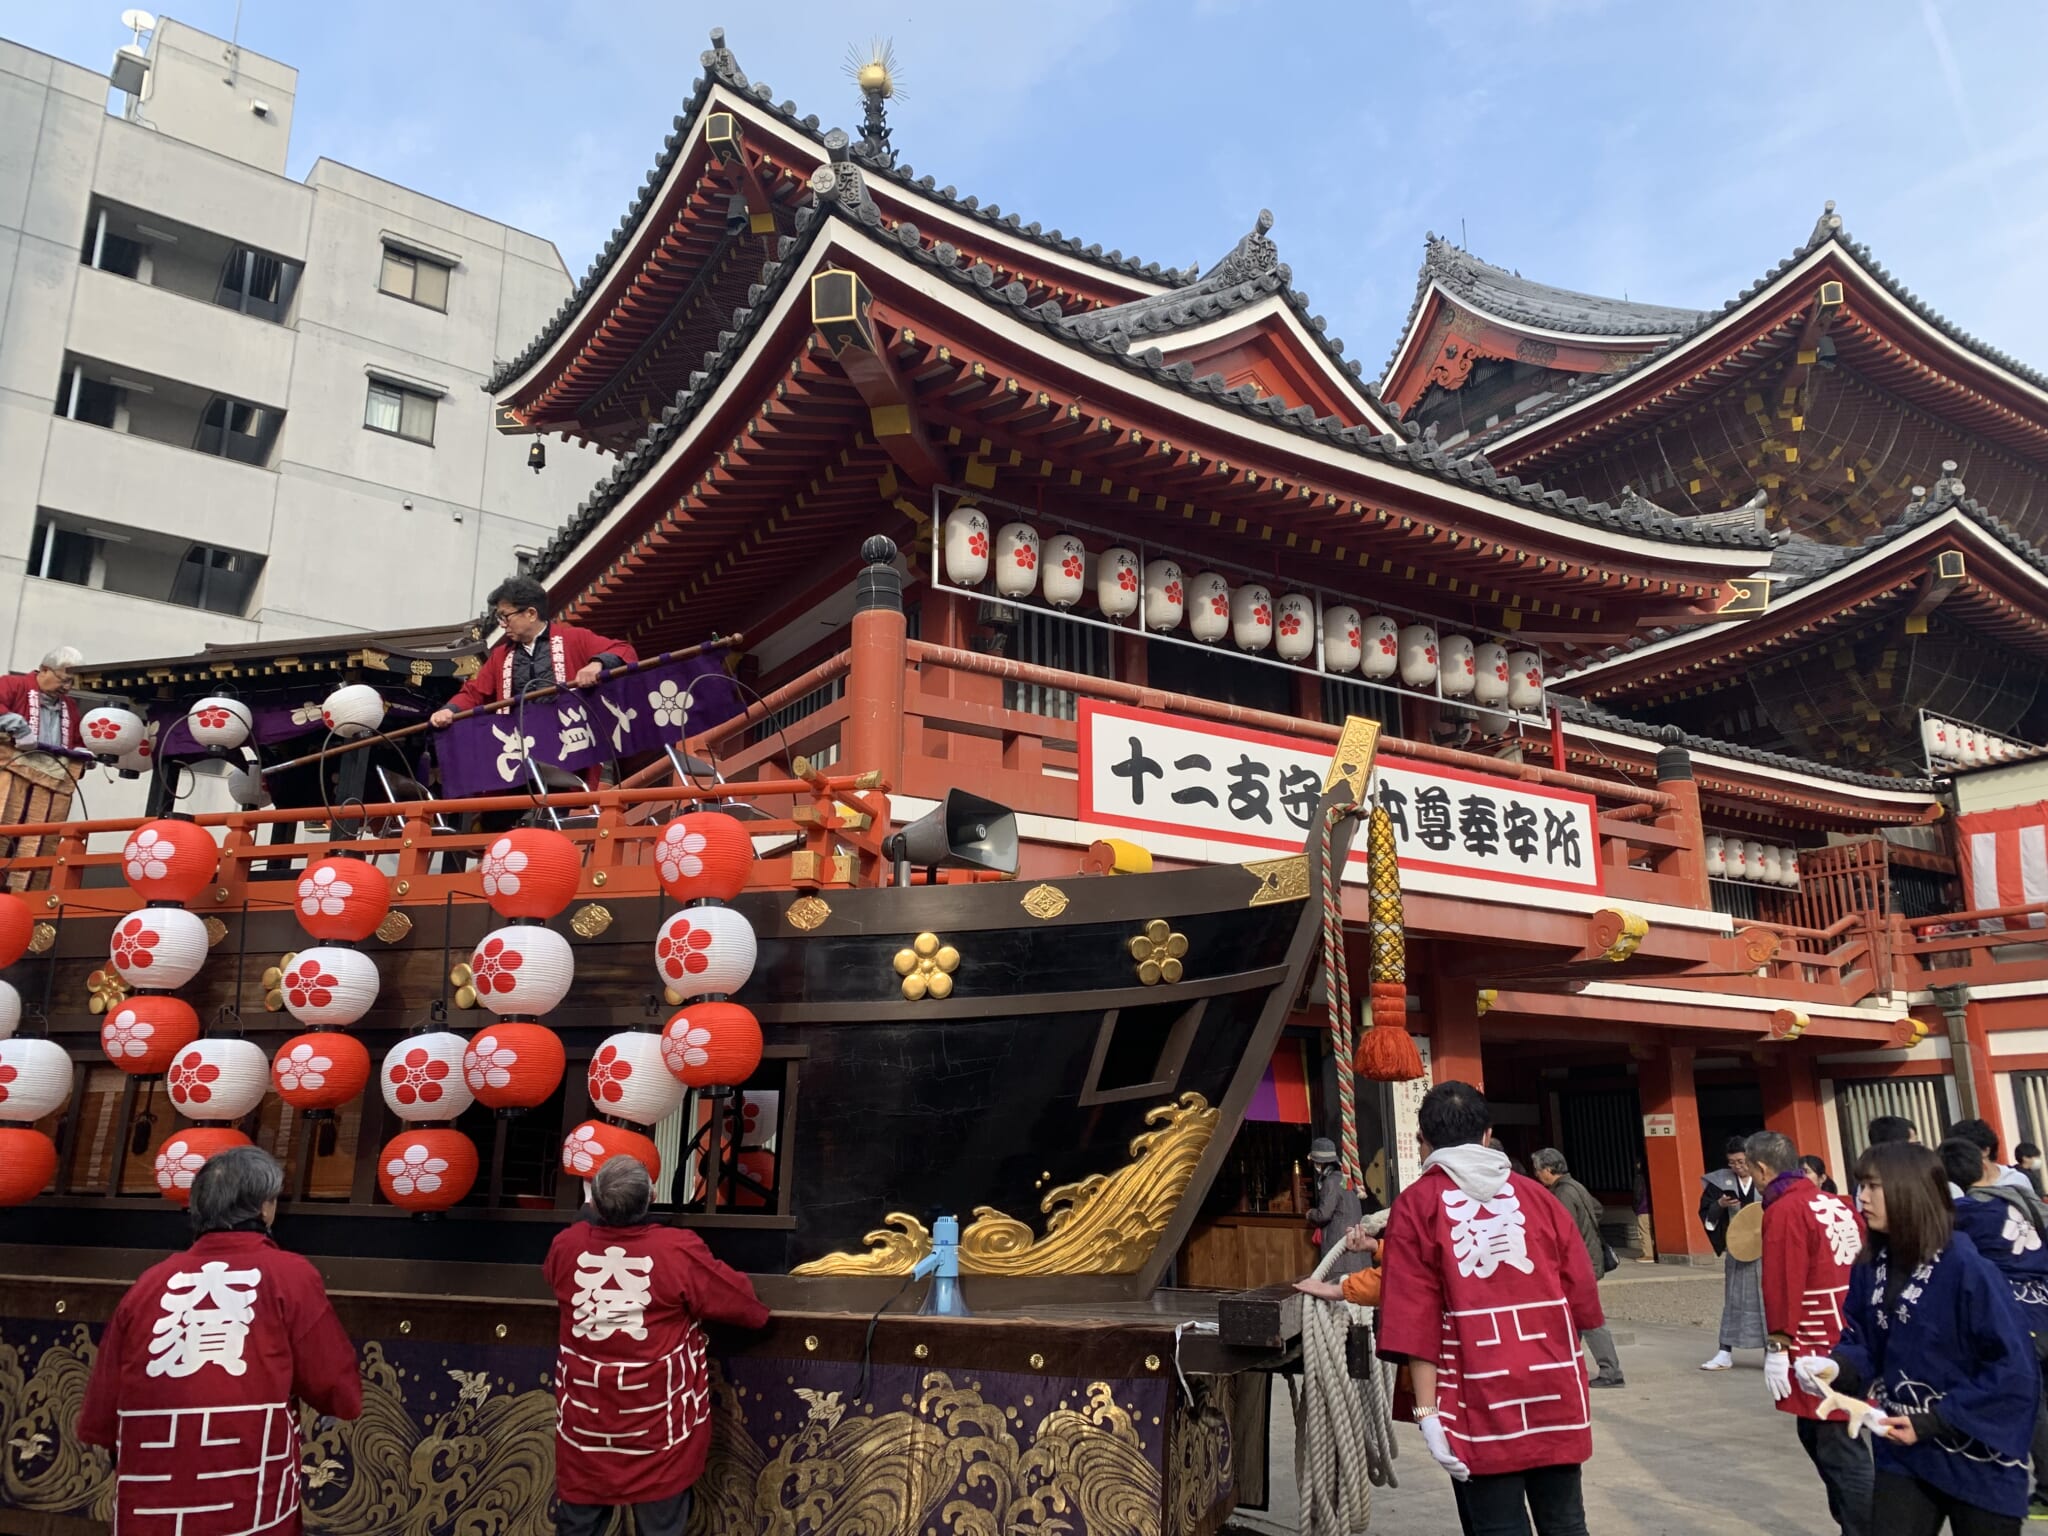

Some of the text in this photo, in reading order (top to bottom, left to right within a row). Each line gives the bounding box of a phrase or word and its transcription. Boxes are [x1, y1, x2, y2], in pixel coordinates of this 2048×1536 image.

[1016, 530, 1038, 545] 奉納
[492, 694, 637, 783] 大須丸
[1111, 736, 1581, 868] 十二支守本尊奉安所
[1650, 1127, 1670, 1135] 出口
[1441, 1183, 1535, 1279] 大須
[1808, 1194, 1862, 1266] 大須
[145, 1261, 262, 1378] 大須
[571, 1246, 654, 1341] 大須
